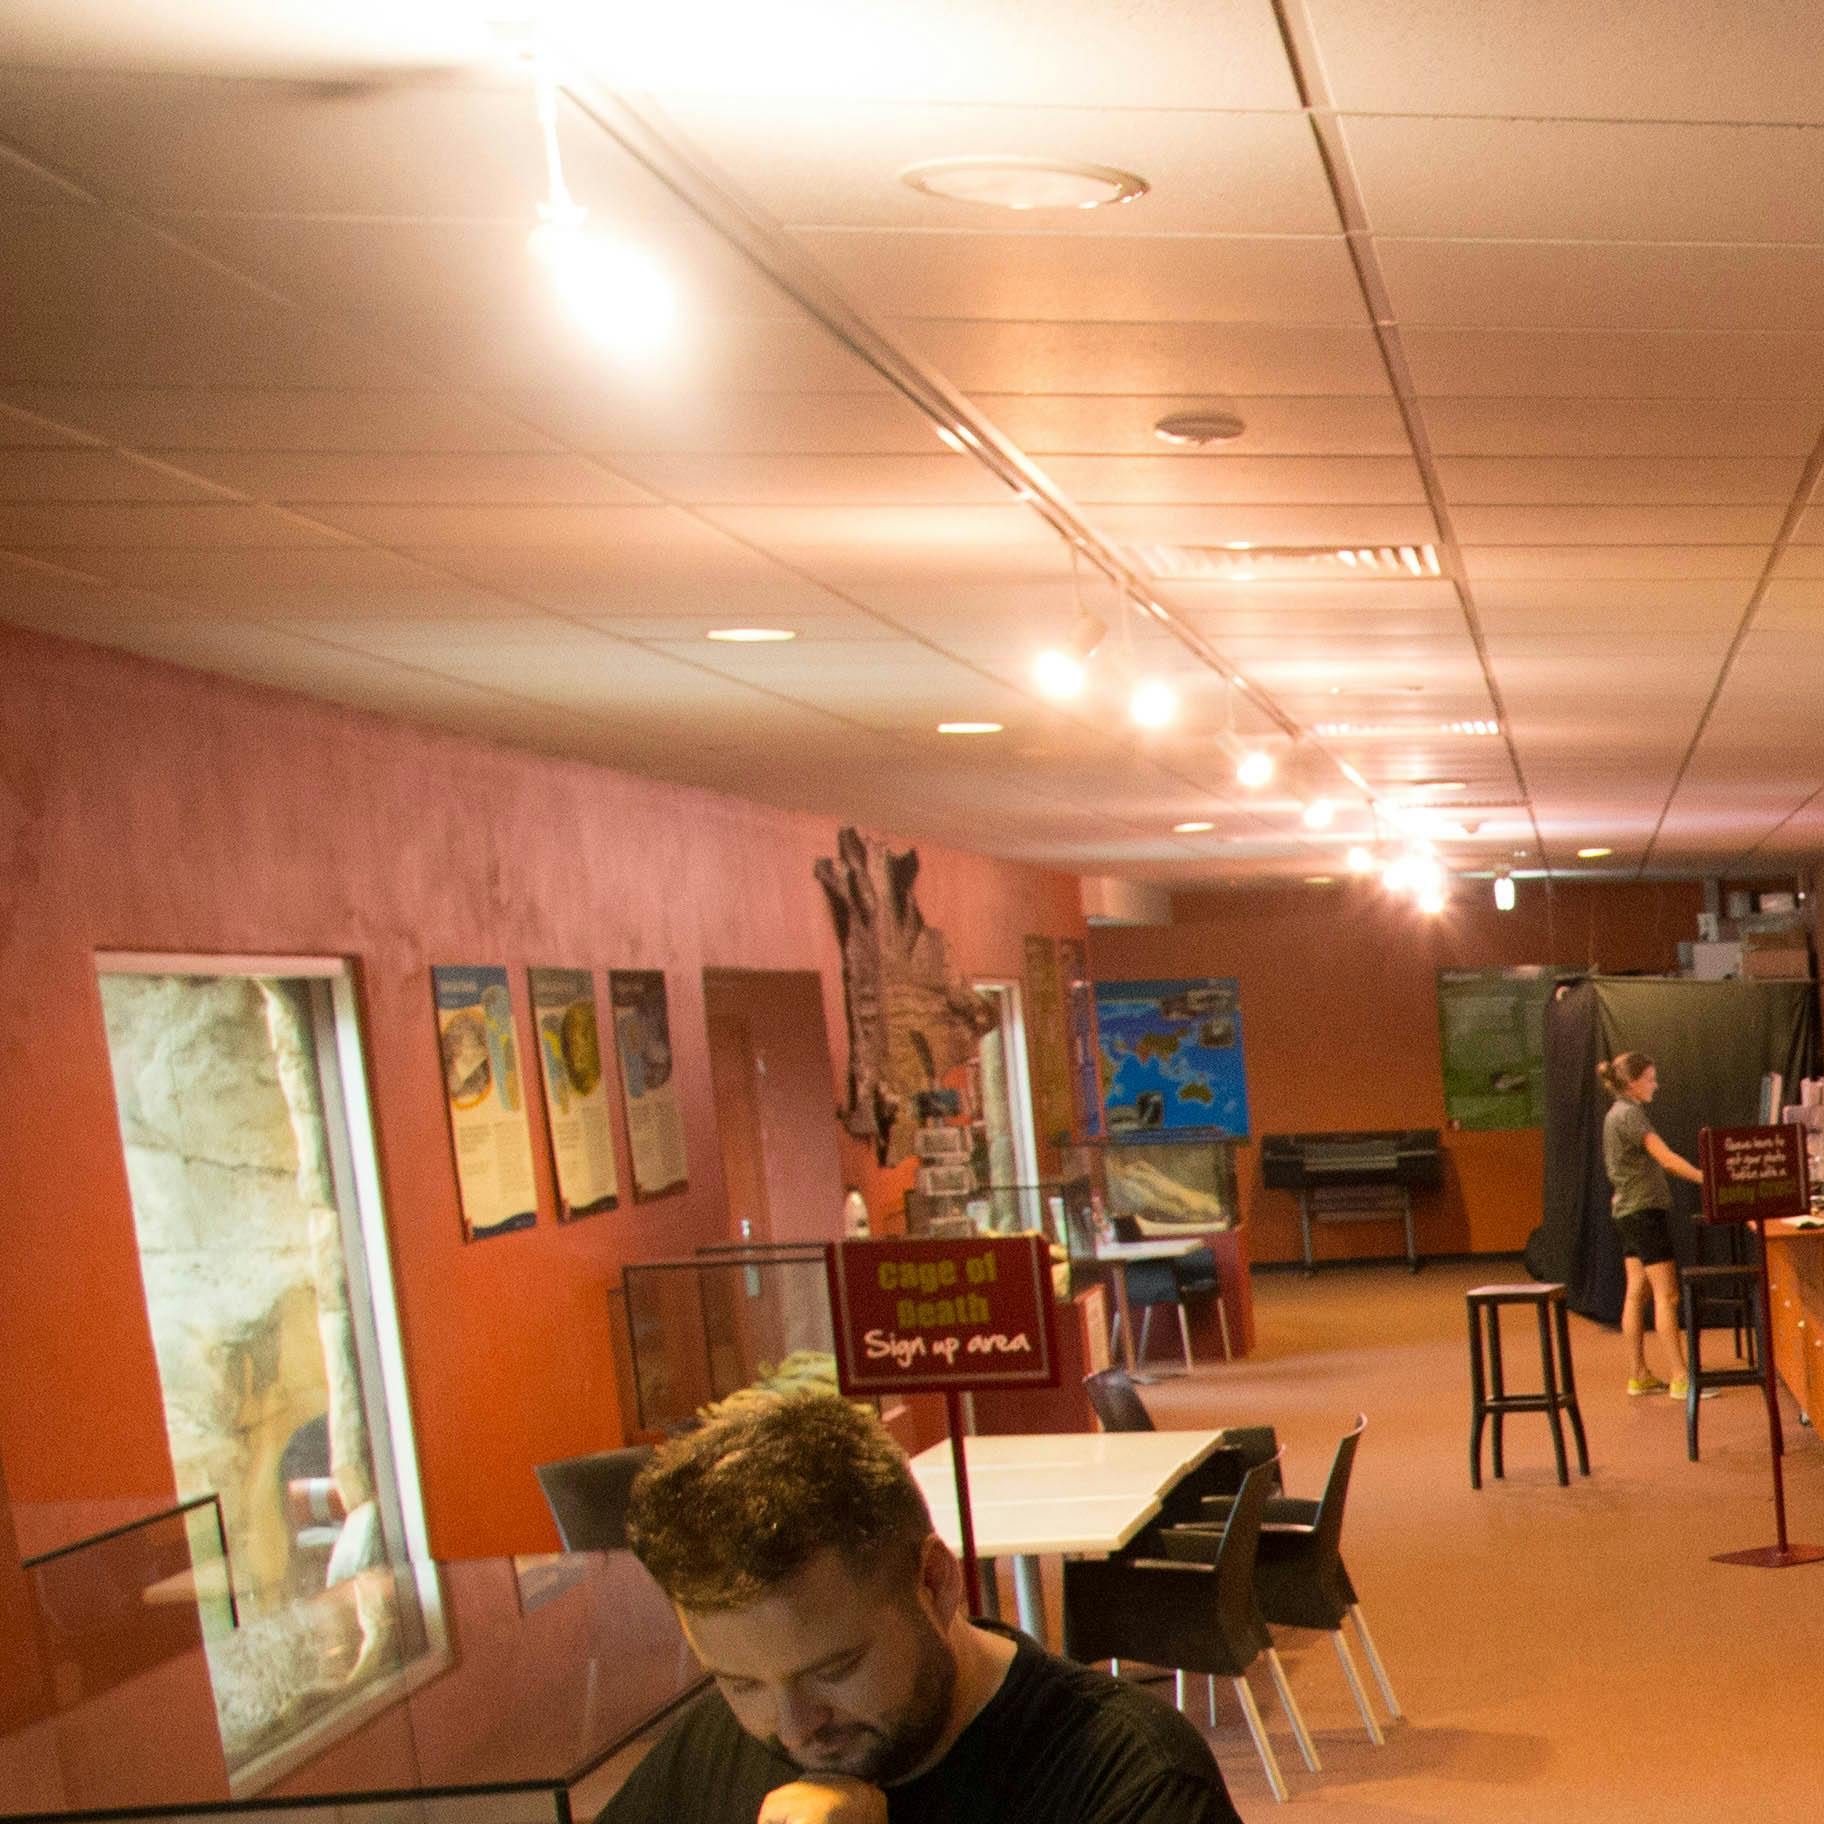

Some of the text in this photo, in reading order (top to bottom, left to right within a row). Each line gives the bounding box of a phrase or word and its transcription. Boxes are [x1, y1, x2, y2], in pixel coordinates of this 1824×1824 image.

[877, 1250, 998, 1294] Cage of
[896, 1292, 991, 1329] Death
[864, 1328, 1033, 1367] Sign up area
